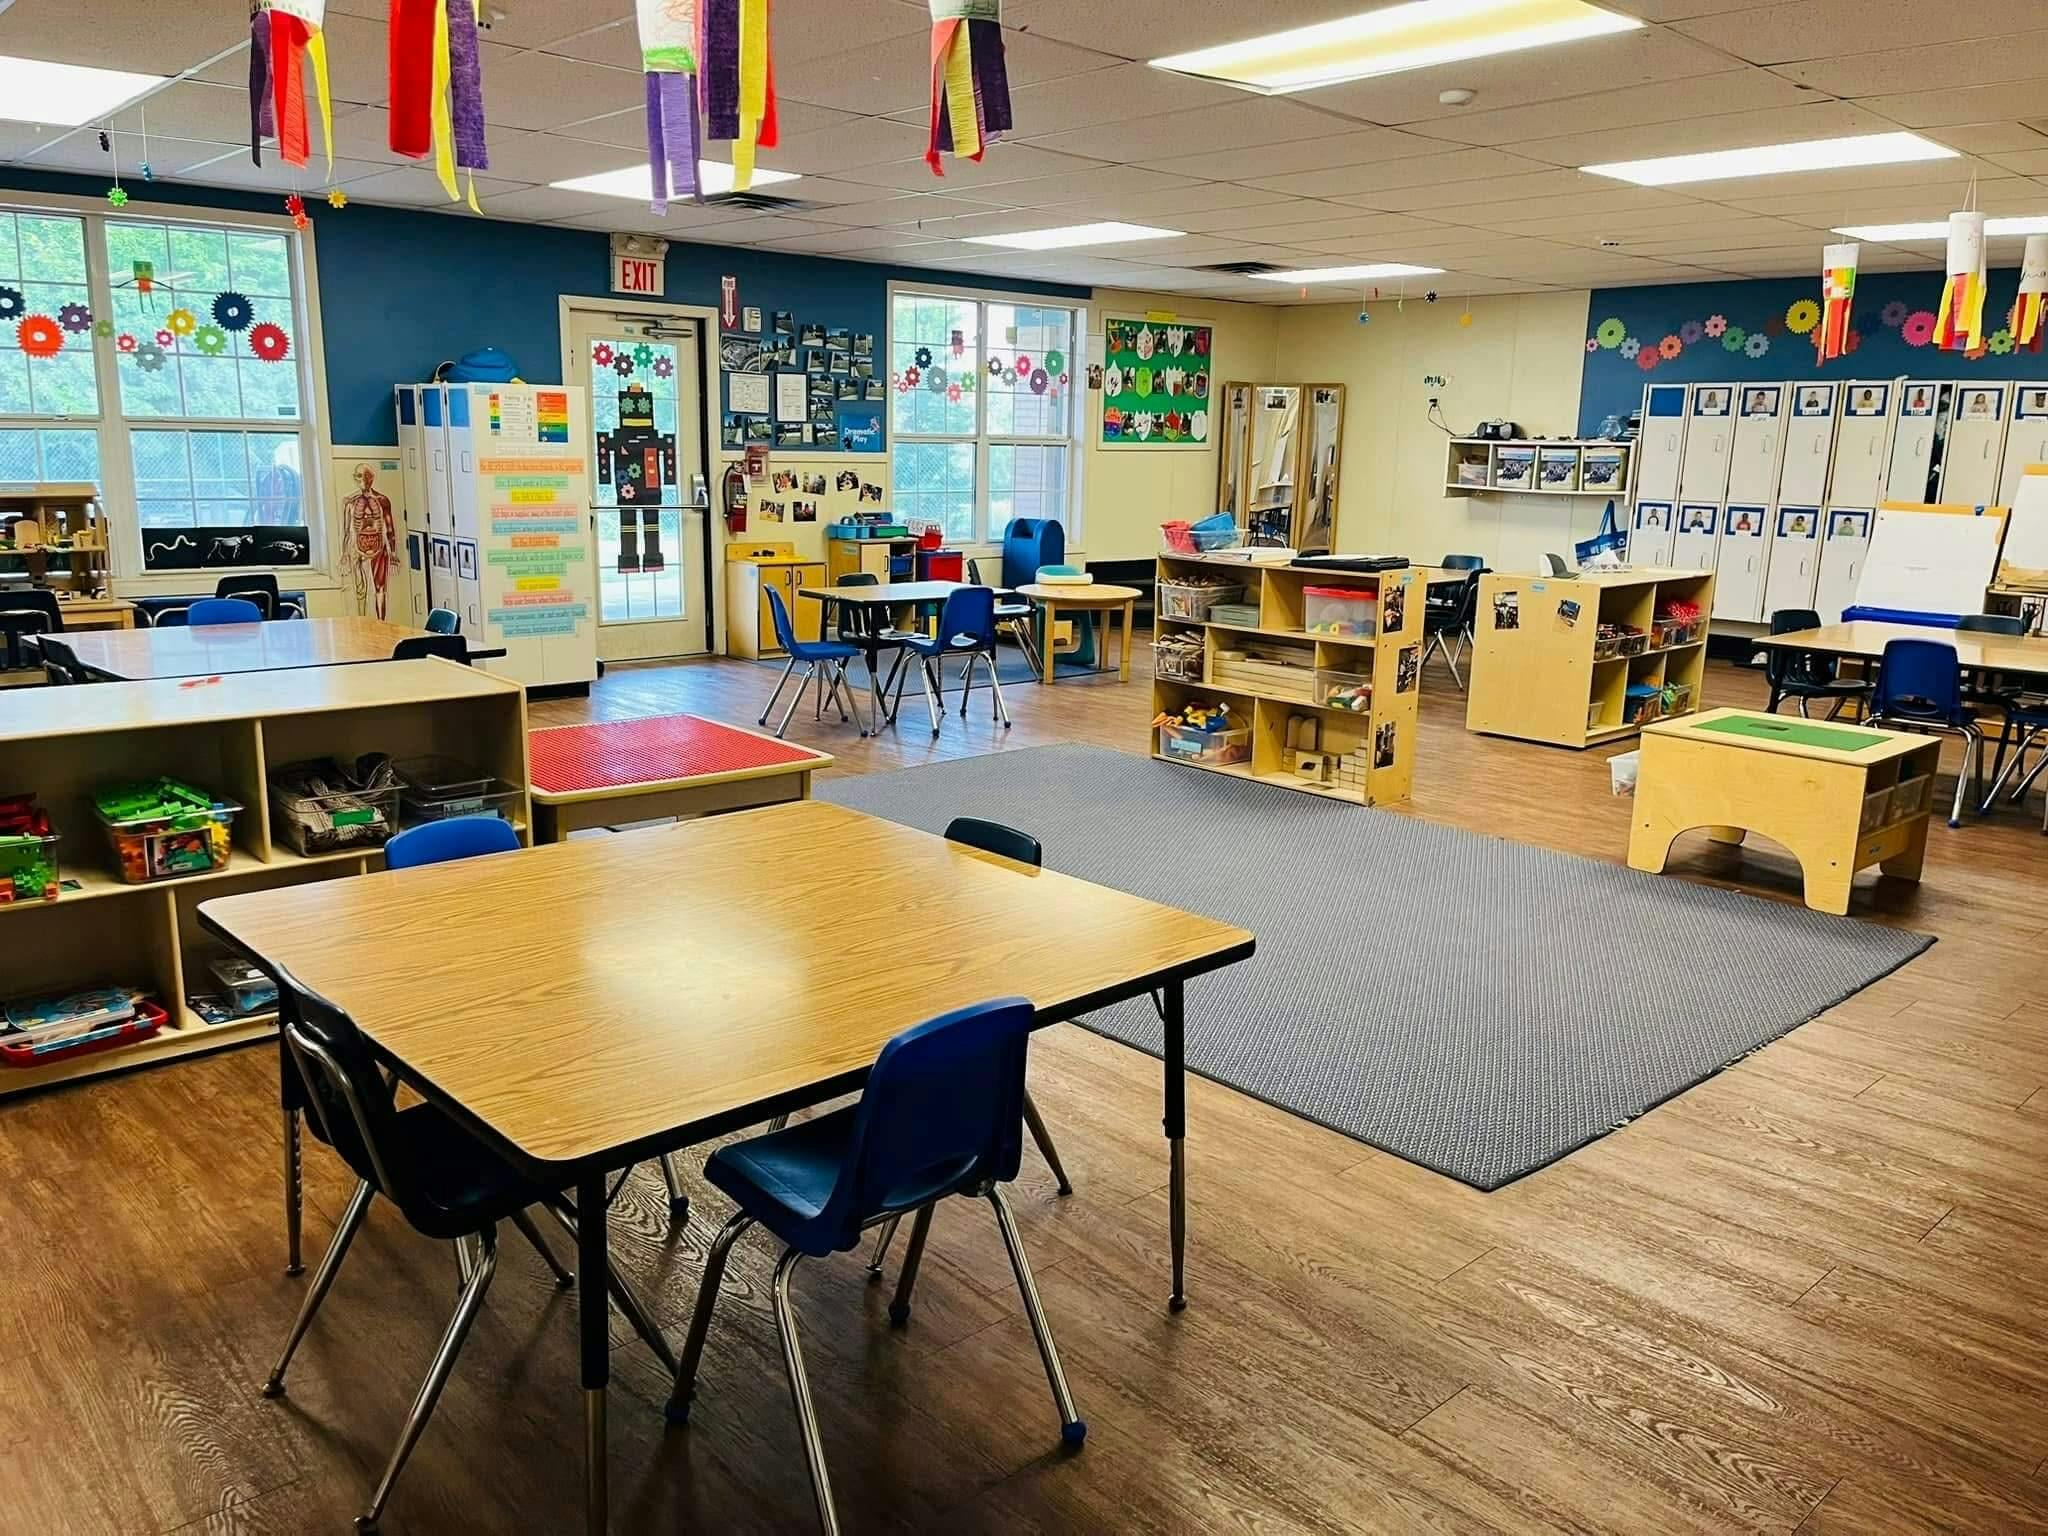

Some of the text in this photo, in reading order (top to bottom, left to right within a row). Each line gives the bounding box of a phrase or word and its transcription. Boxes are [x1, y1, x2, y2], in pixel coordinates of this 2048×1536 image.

[622, 260, 656, 292] EXIT
[844, 427, 875, 436] Dramatic
[852, 435, 868, 445] Play
